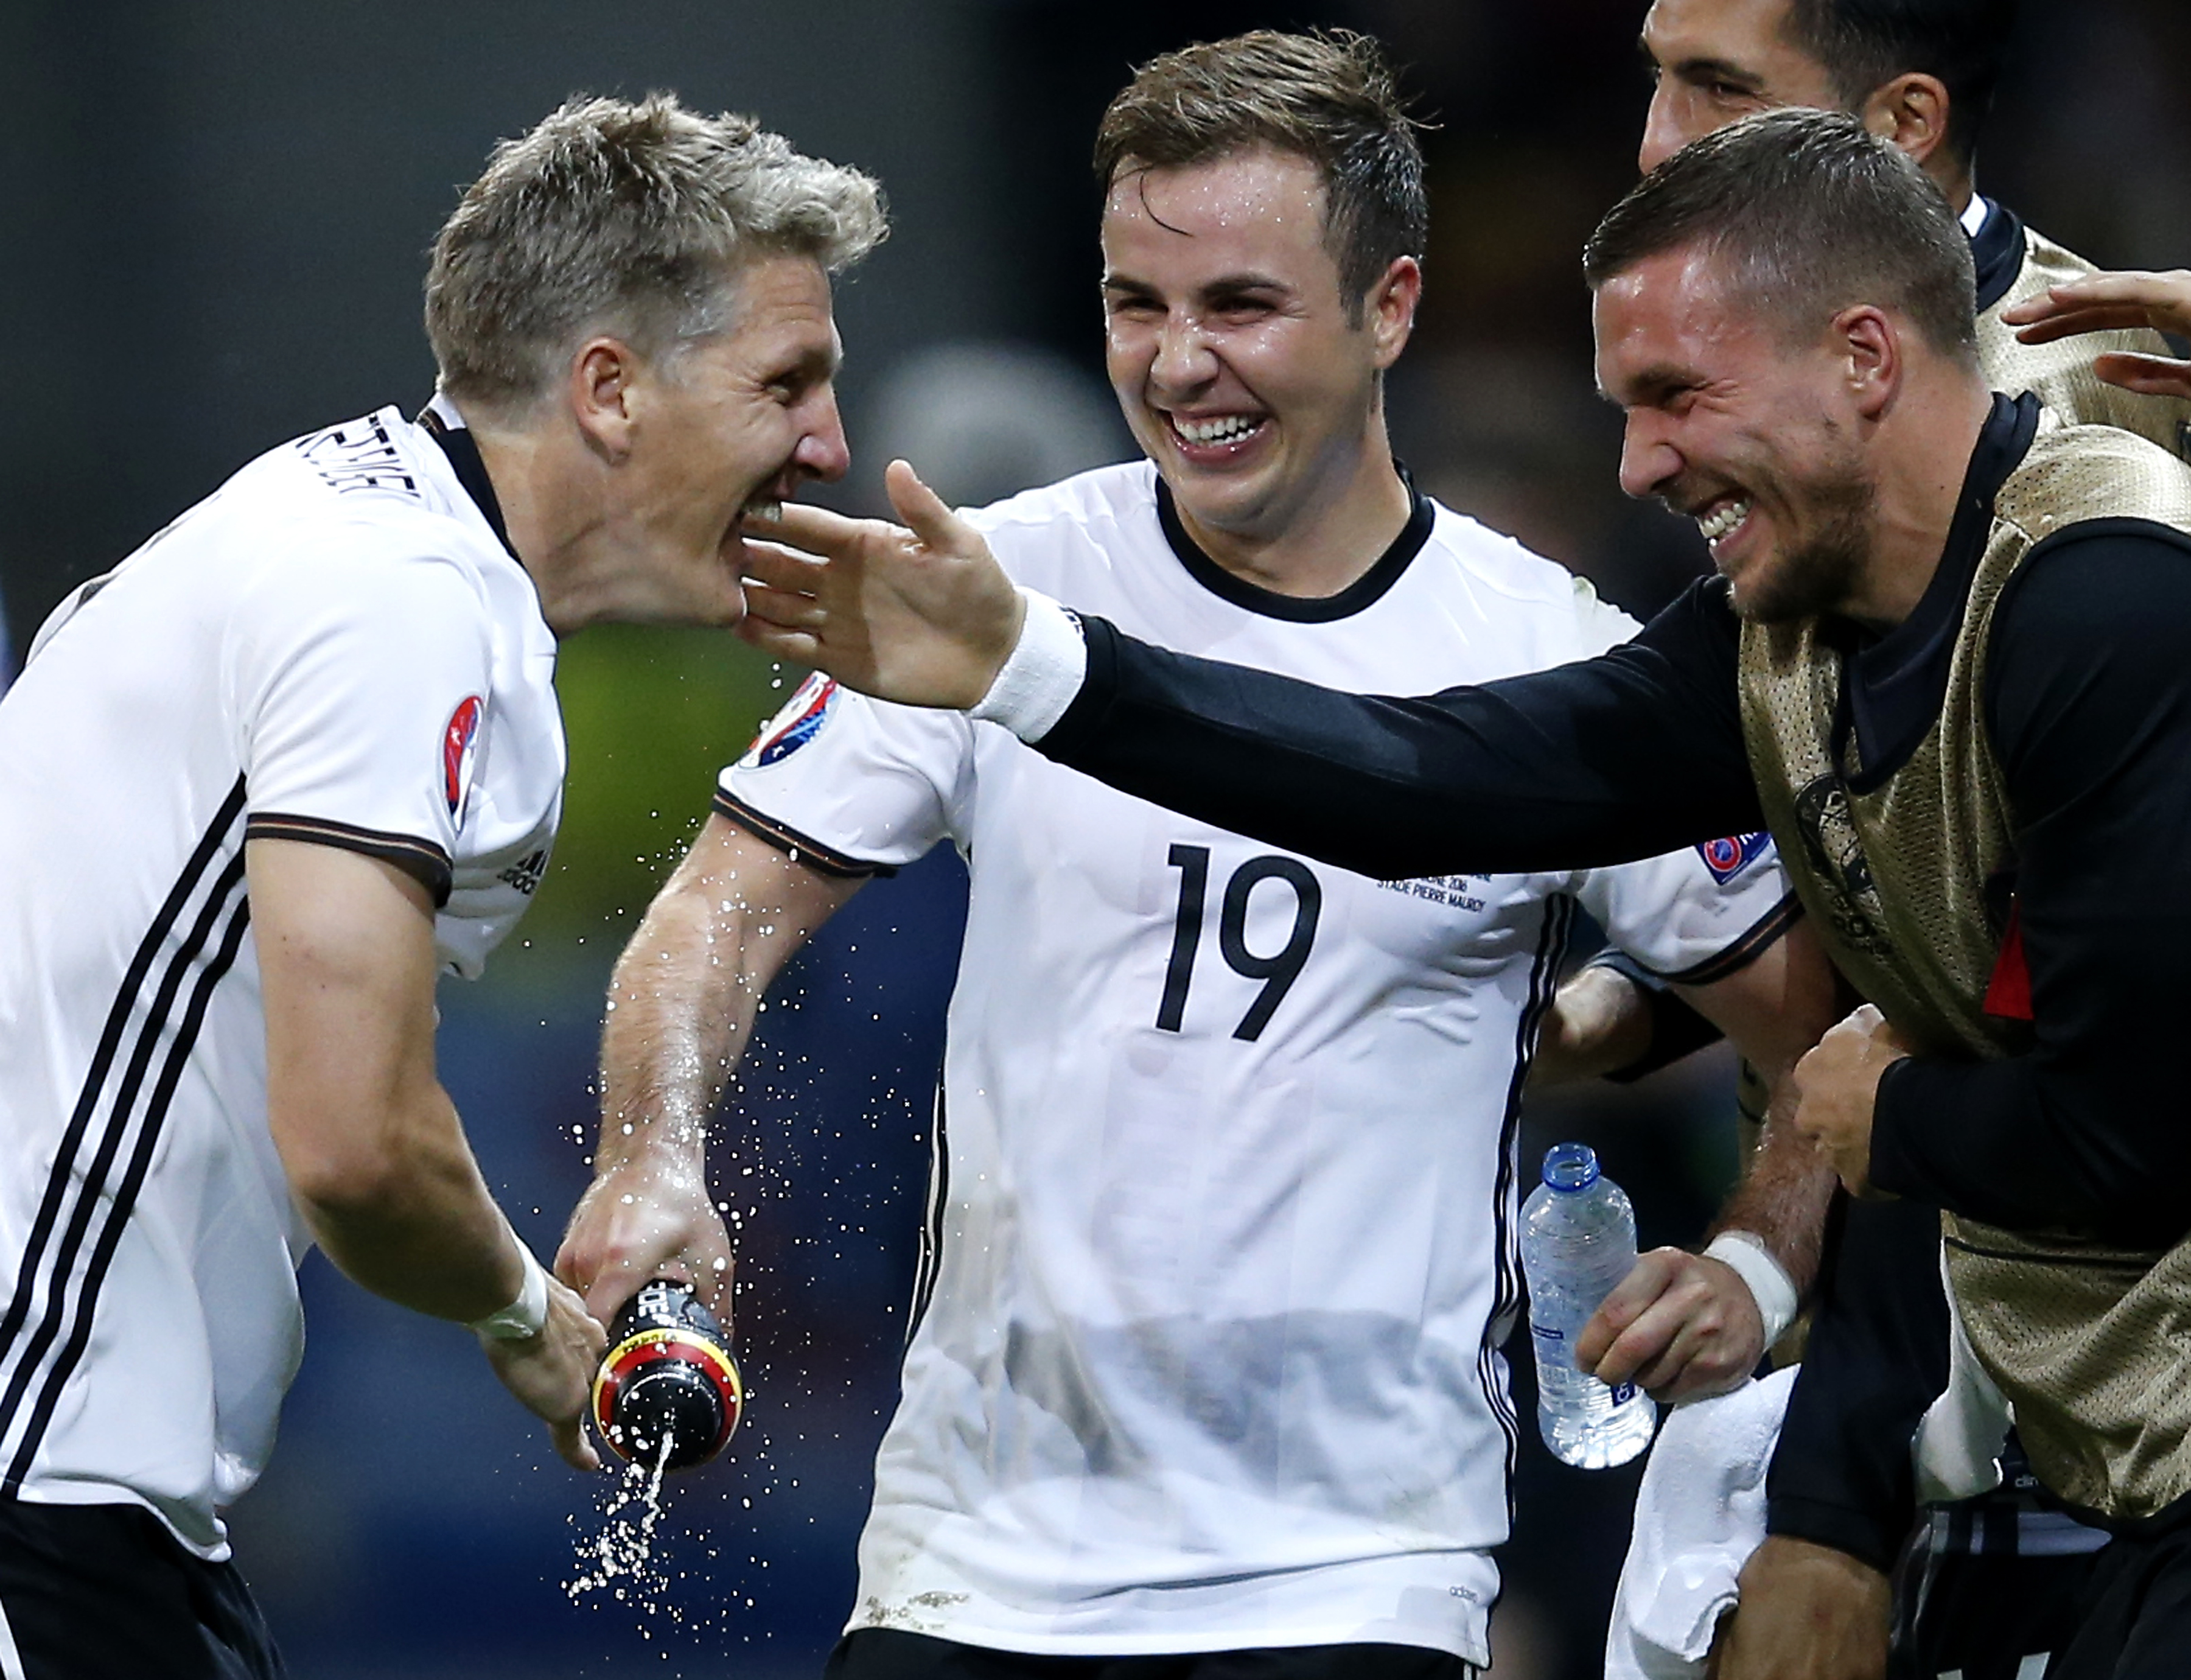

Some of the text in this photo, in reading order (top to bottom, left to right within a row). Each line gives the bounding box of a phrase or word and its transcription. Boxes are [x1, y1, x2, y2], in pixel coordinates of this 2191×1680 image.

[1156, 843, 1322, 1042] 19
[1412, 884, 1447, 905] PIERRE
[1447, 892, 1486, 912] MAUROY
